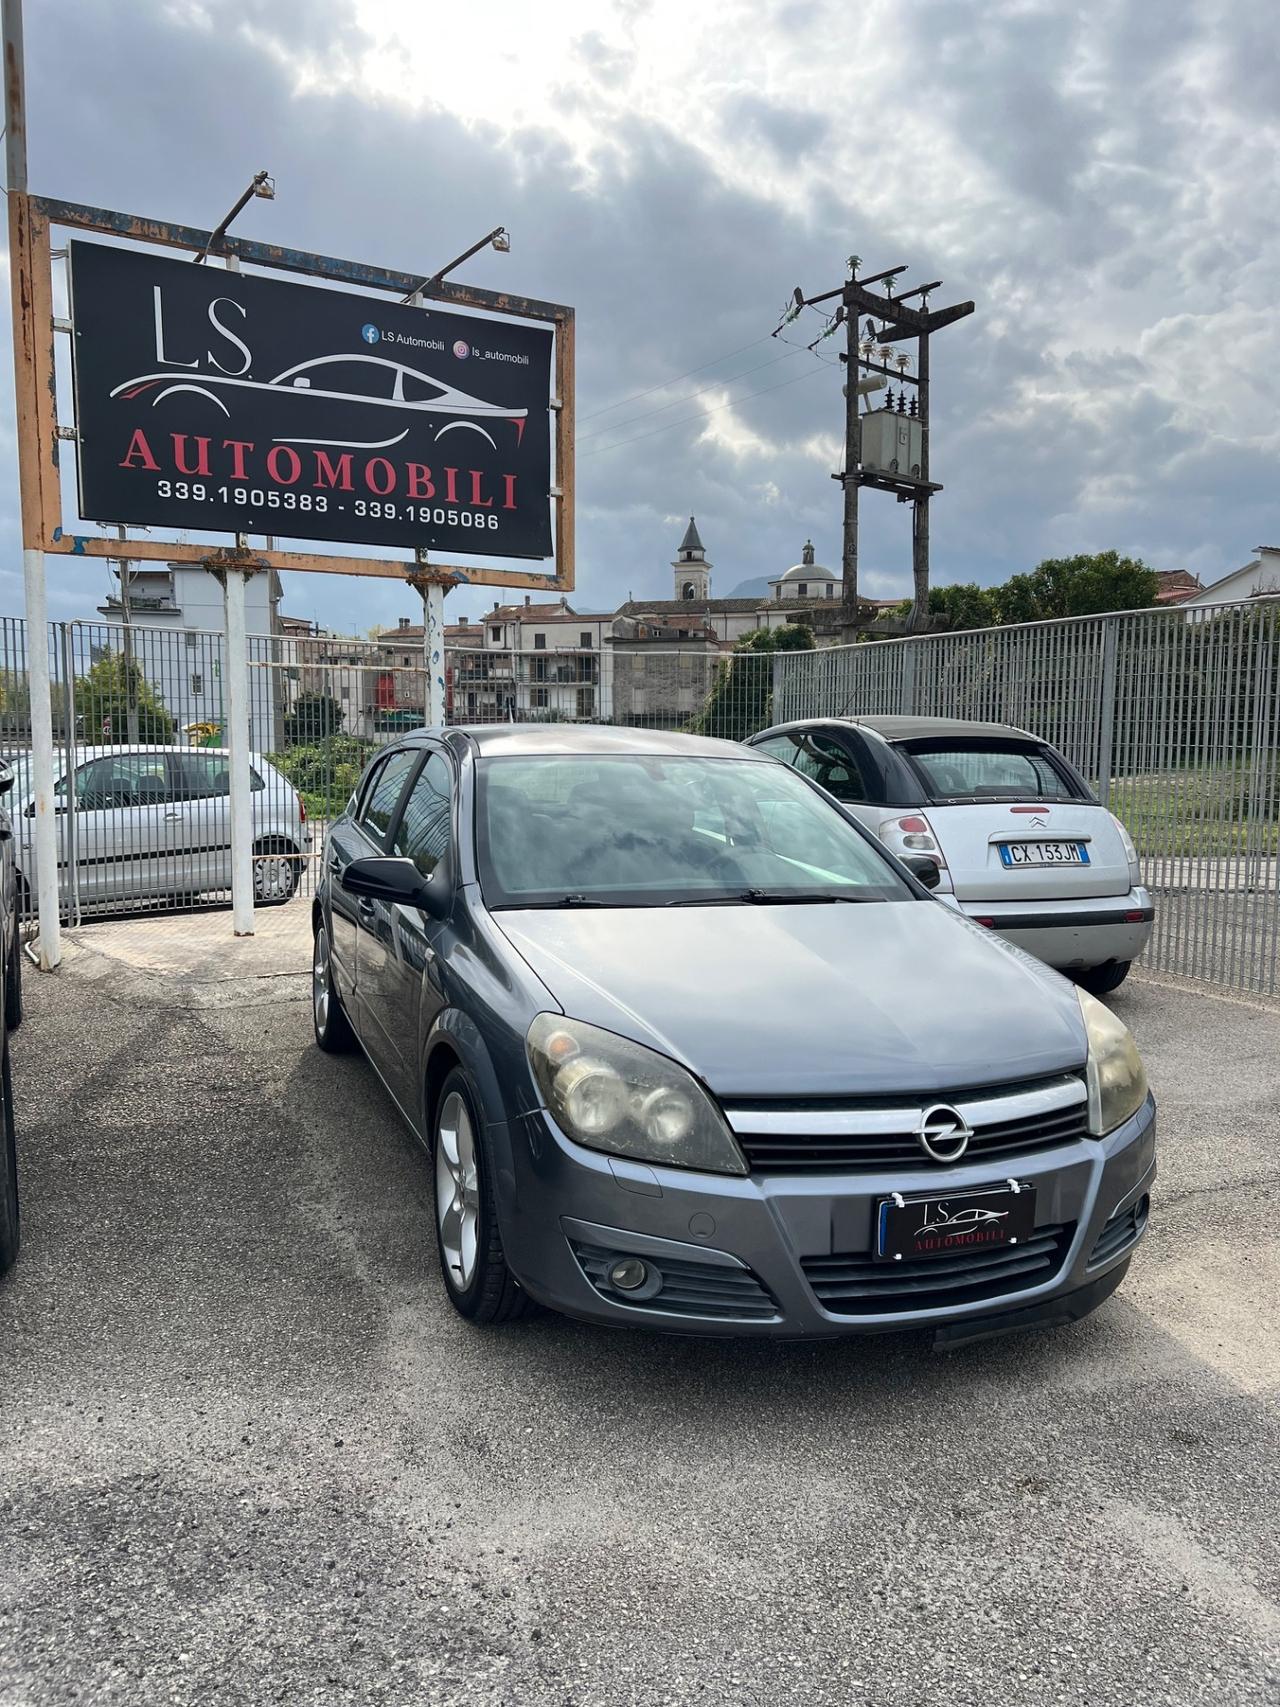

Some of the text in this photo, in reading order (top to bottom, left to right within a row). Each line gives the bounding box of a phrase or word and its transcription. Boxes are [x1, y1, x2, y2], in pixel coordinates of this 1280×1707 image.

[381, 330, 445, 351] LS Automobili
[471, 346, 529, 365] ls_automobili
[118, 427, 518, 510] AUTOMOBILI
[157, 479, 329, 513] 339.1905383
[354, 500, 500, 530] 339.1905086
[1011, 845, 1032, 862] CX
[1036, 844, 1081, 861] 153JM
